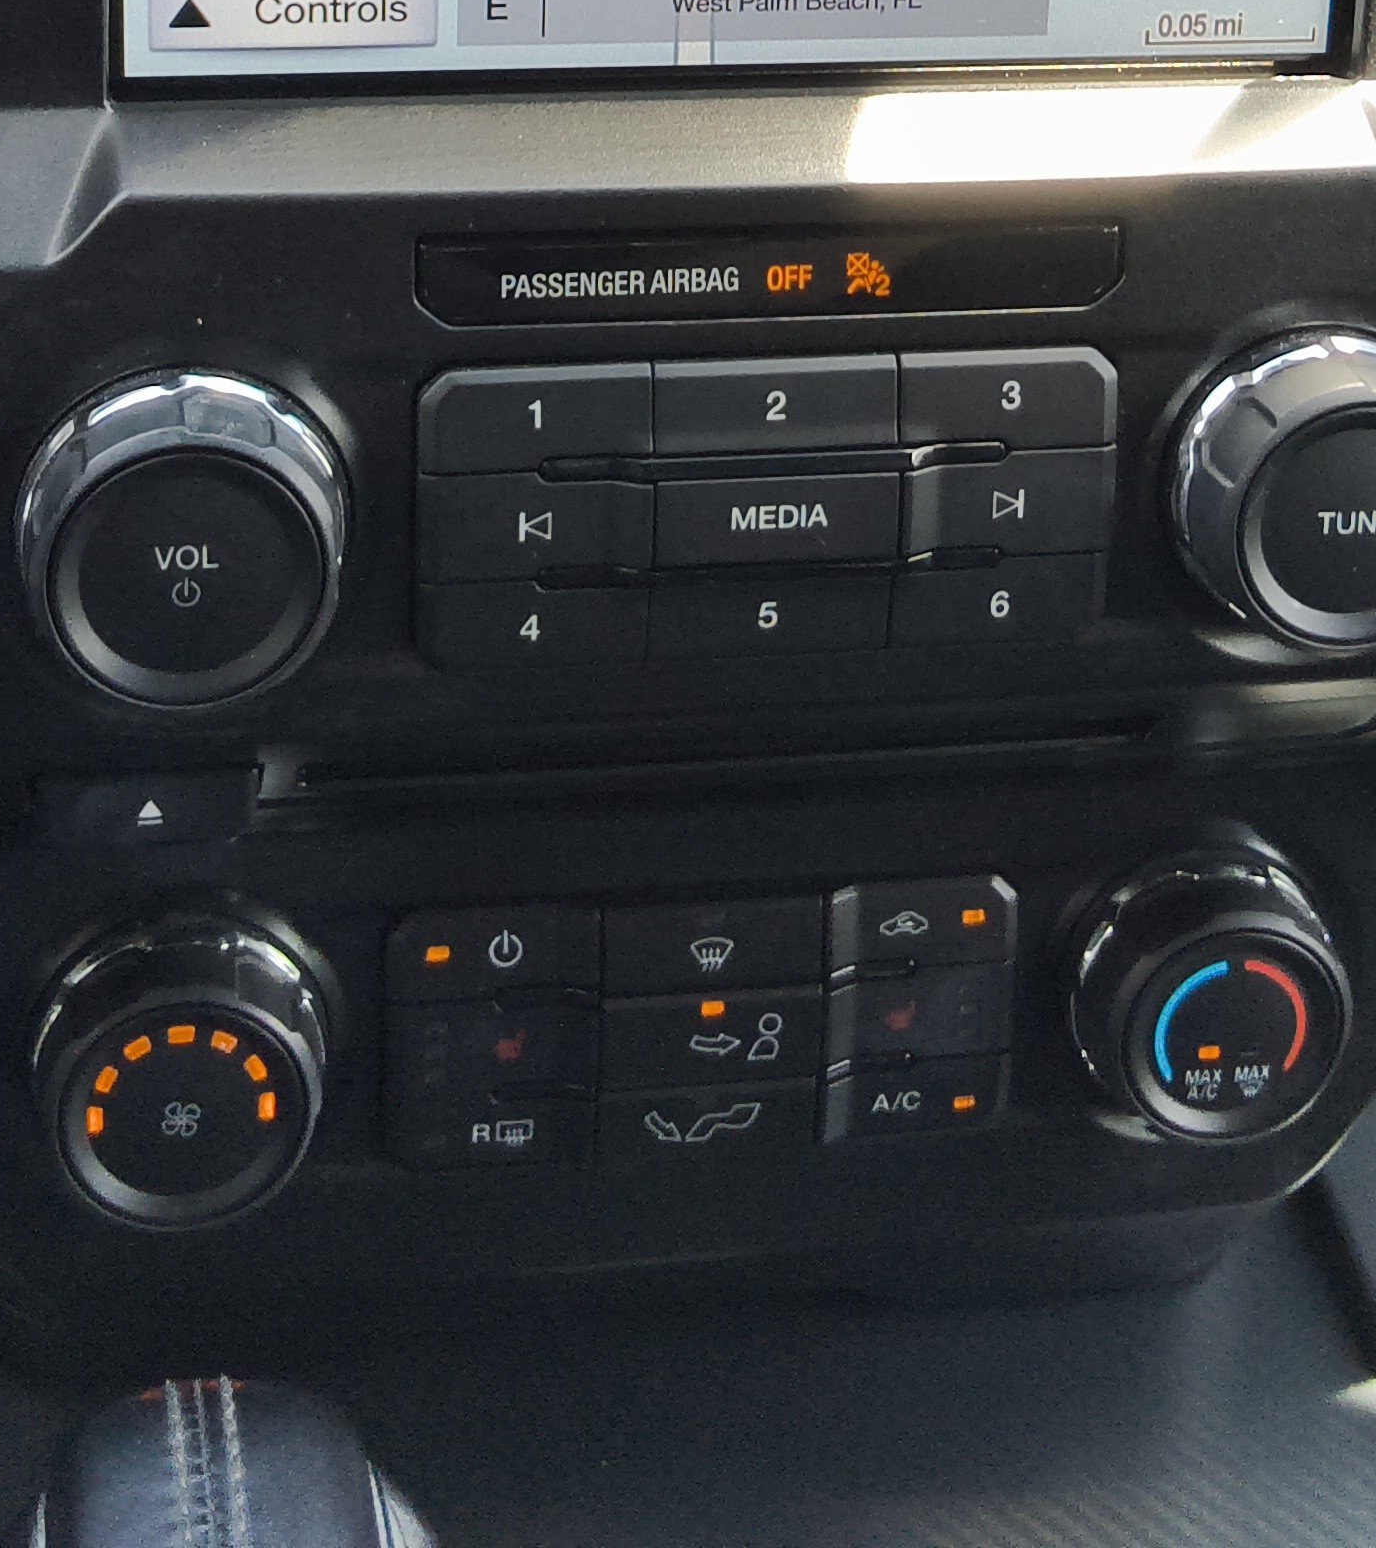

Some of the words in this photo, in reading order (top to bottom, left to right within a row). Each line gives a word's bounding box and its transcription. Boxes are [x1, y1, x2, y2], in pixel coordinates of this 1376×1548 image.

[1158, 13, 1207, 38] 0.05
[1213, 12, 1243, 36] mi
[500, 269, 645, 300] PASSENGER
[650, 266, 739, 295] AIRBAG
[766, 264, 814, 293] OFF
[765, 392, 788, 421] 2
[1000, 380, 1022, 410] 3
[529, 399, 544, 429] 1
[730, 503, 828, 531] MEDIA
[154, 545, 219, 571] VOL
[757, 602, 778, 629] 5
[989, 591, 1010, 618] 6
[520, 614, 541, 641] 4
[1184, 1068, 1223, 1086] MAX
[1233, 1064, 1271, 1083] MAX
[872, 1090, 921, 1113] A/C
[1186, 1084, 1219, 1101] A/C
